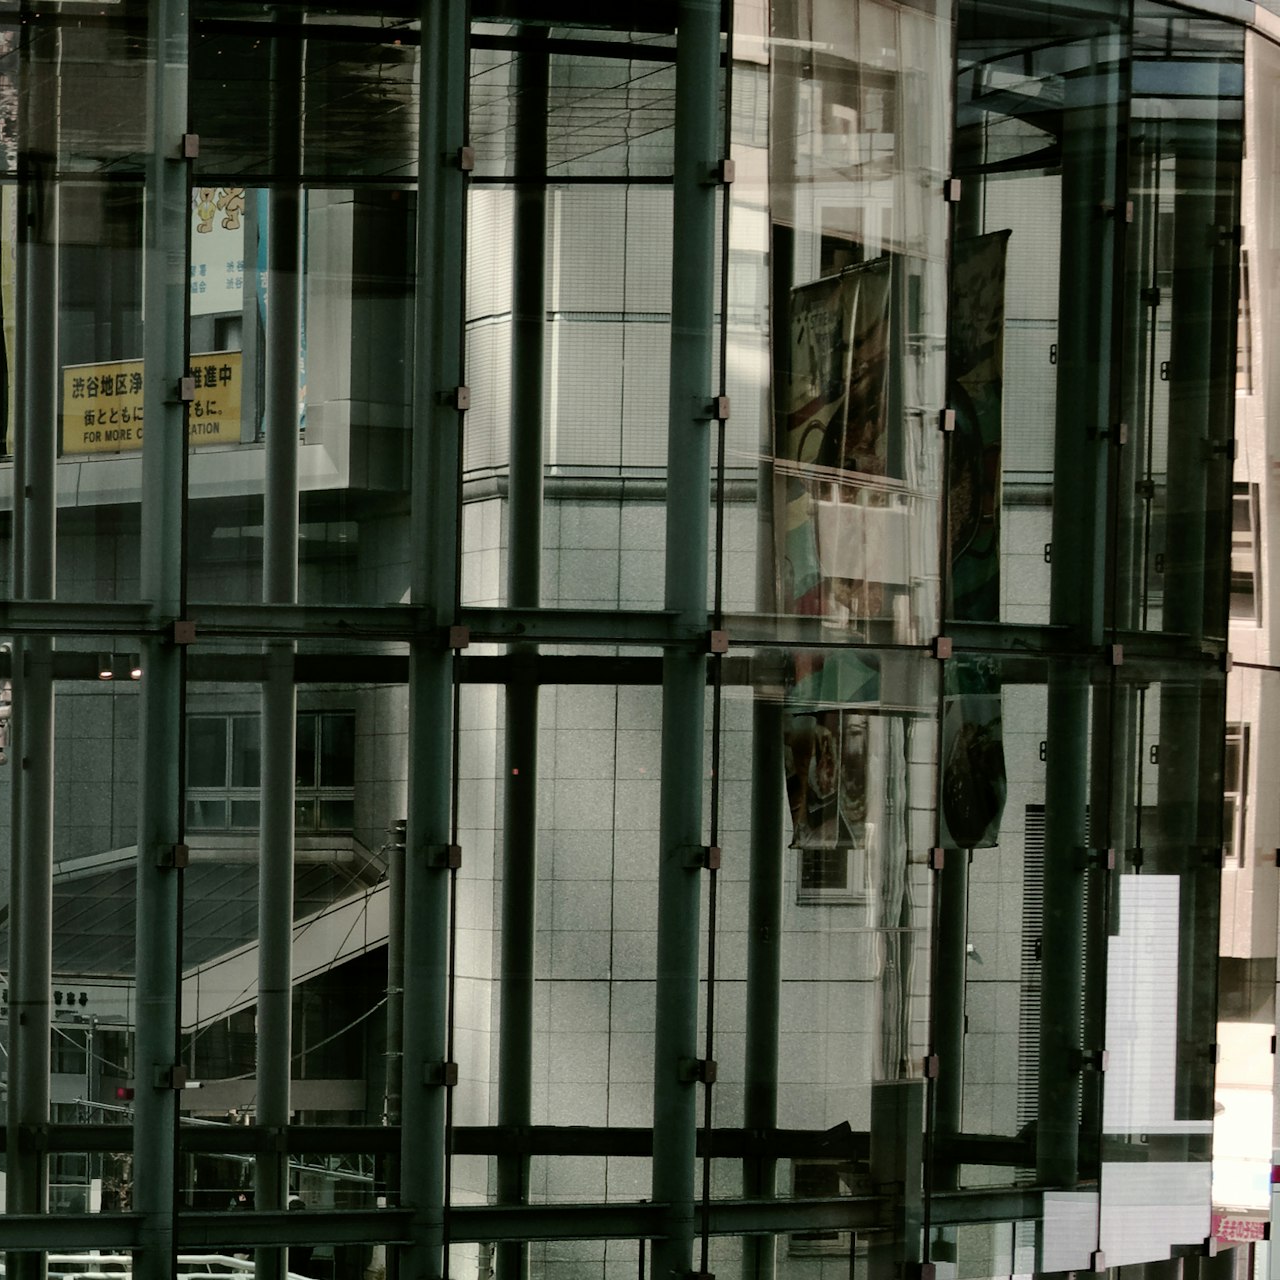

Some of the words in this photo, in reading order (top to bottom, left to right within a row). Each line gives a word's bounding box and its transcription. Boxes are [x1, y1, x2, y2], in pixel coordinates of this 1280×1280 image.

[188, 400, 224, 418] もに。
[83, 432, 102, 444] FOR
[104, 428, 132, 442] MORE
[189, 421, 220, 436] ATION
